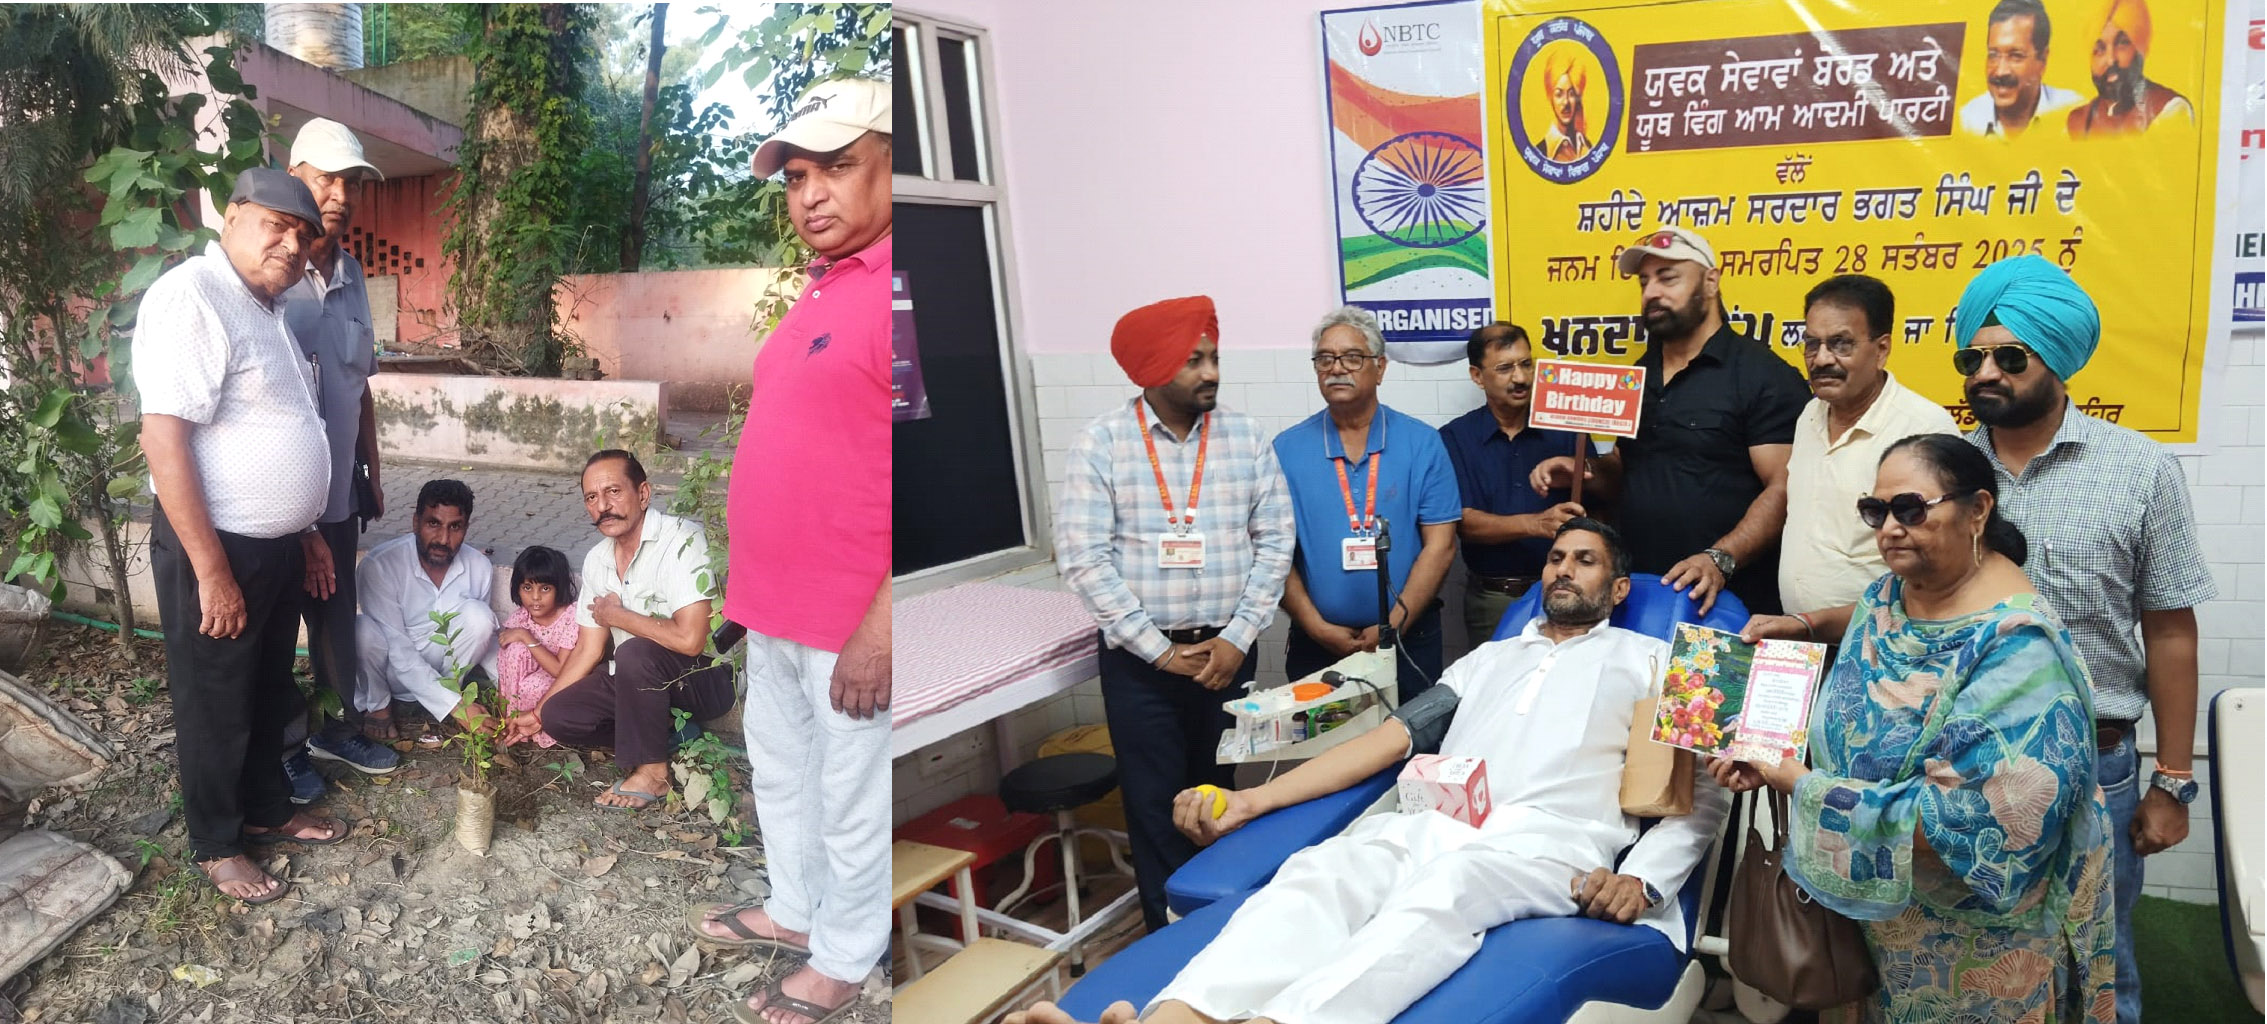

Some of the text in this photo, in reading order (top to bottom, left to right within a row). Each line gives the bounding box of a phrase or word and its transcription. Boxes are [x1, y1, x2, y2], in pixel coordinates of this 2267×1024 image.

[1383, 23, 1441, 42] NBTC
[1644, 36, 1943, 107] ਯੁਵਕ ਸੇਵਾਵਾਂ ਬੋਰਡ ਅਤੇ
[1635, 85, 1951, 151] ਯੂਥ ਵਿੰਗ ਆਮ ਆਦਮੀ ਪਾਰਟੀ
[1775, 152, 1812, 184] ਵੱਲੋਂ
[1577, 169, 2081, 232] ਸ਼ਹੀਦੇ ਆਜ਼ਮ ਸਰਦਾਰ ਭਗਤ ਸਿੰਘ ਜੀ ਦੇ
[1547, 255, 1600, 282] ਜਨਮ
[1718, 237, 1824, 277] ਸਮਰਪਿਤ
[1833, 244, 1868, 274] 28
[1881, 231, 1964, 271] ਸਤੰਬਰ
[1903, 317, 1935, 344] ਜਾ
[1559, 367, 1618, 390] Happy
[1545, 390, 1627, 416] Birthday
